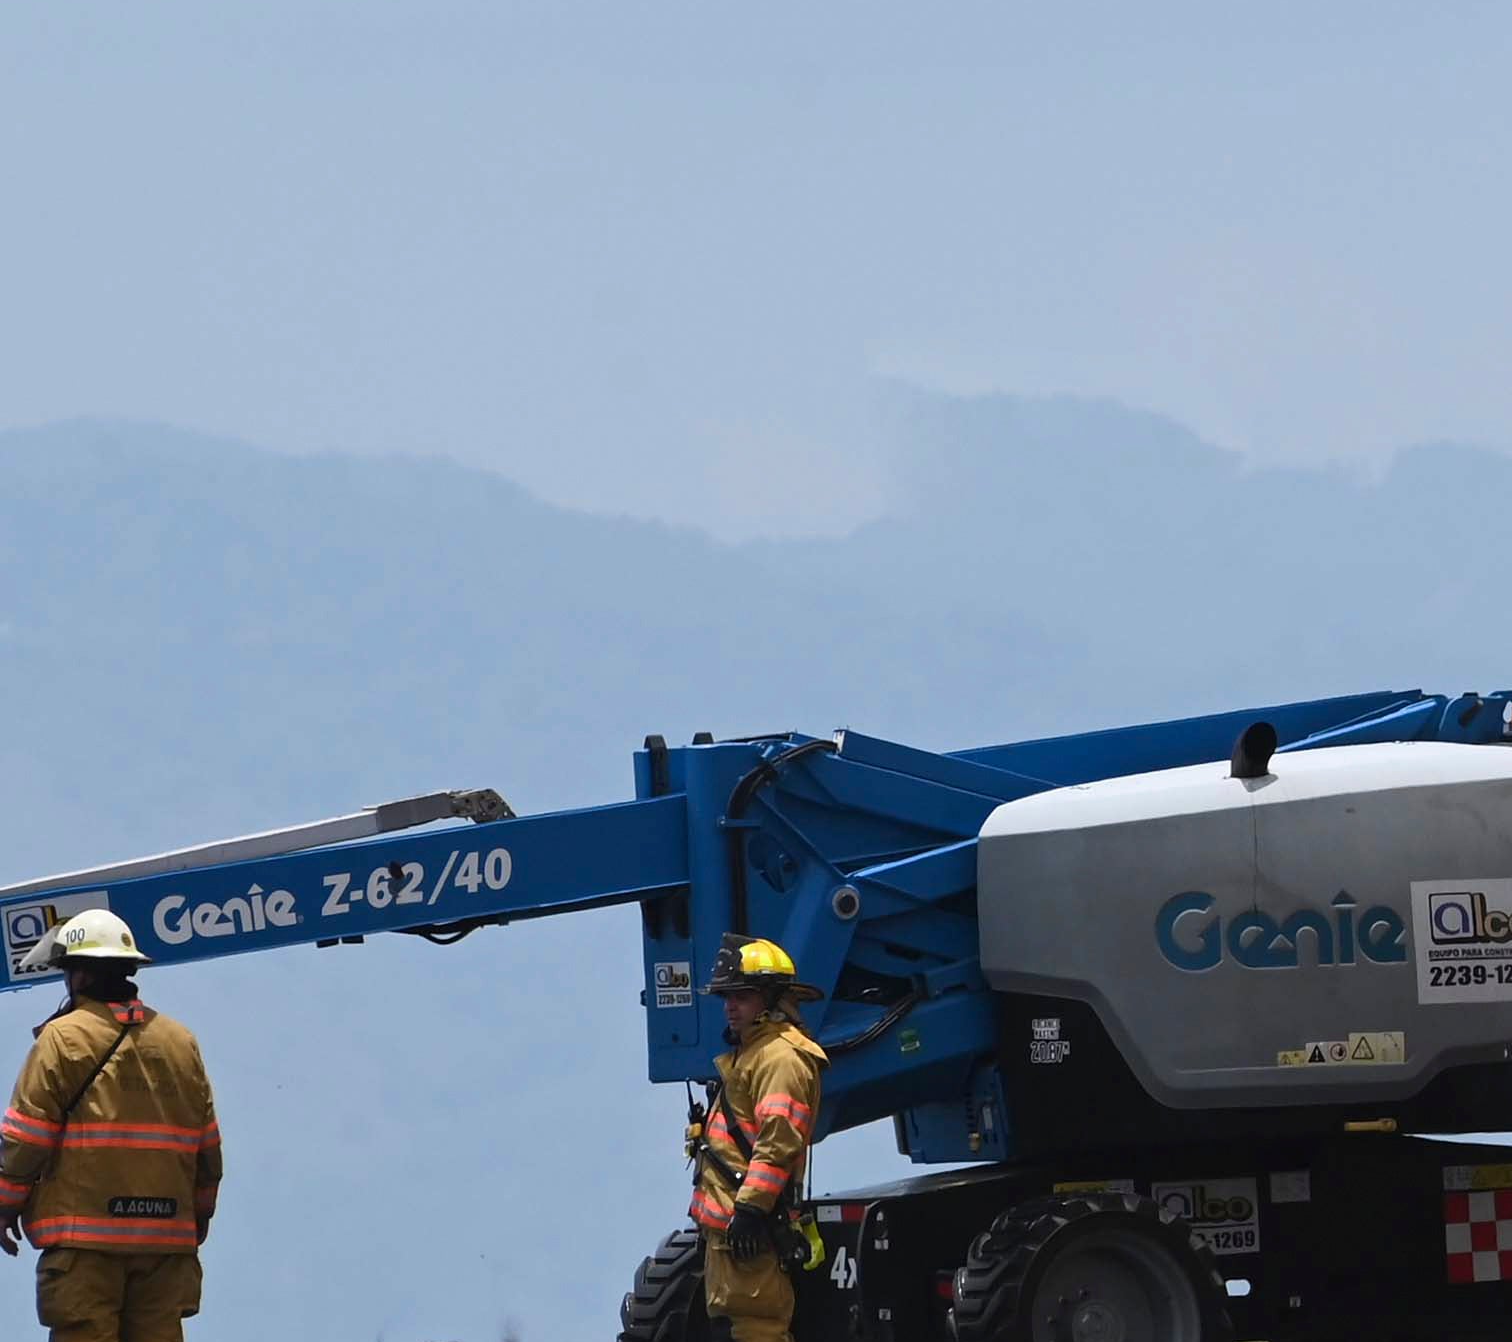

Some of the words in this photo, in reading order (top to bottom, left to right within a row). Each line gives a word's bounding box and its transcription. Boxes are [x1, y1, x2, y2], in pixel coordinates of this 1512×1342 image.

[152, 882, 297, 945] Genie
[1154, 888, 1408, 972] Genie
[65, 927, 86, 944] 100
[1461, 948, 1483, 957] PARA
